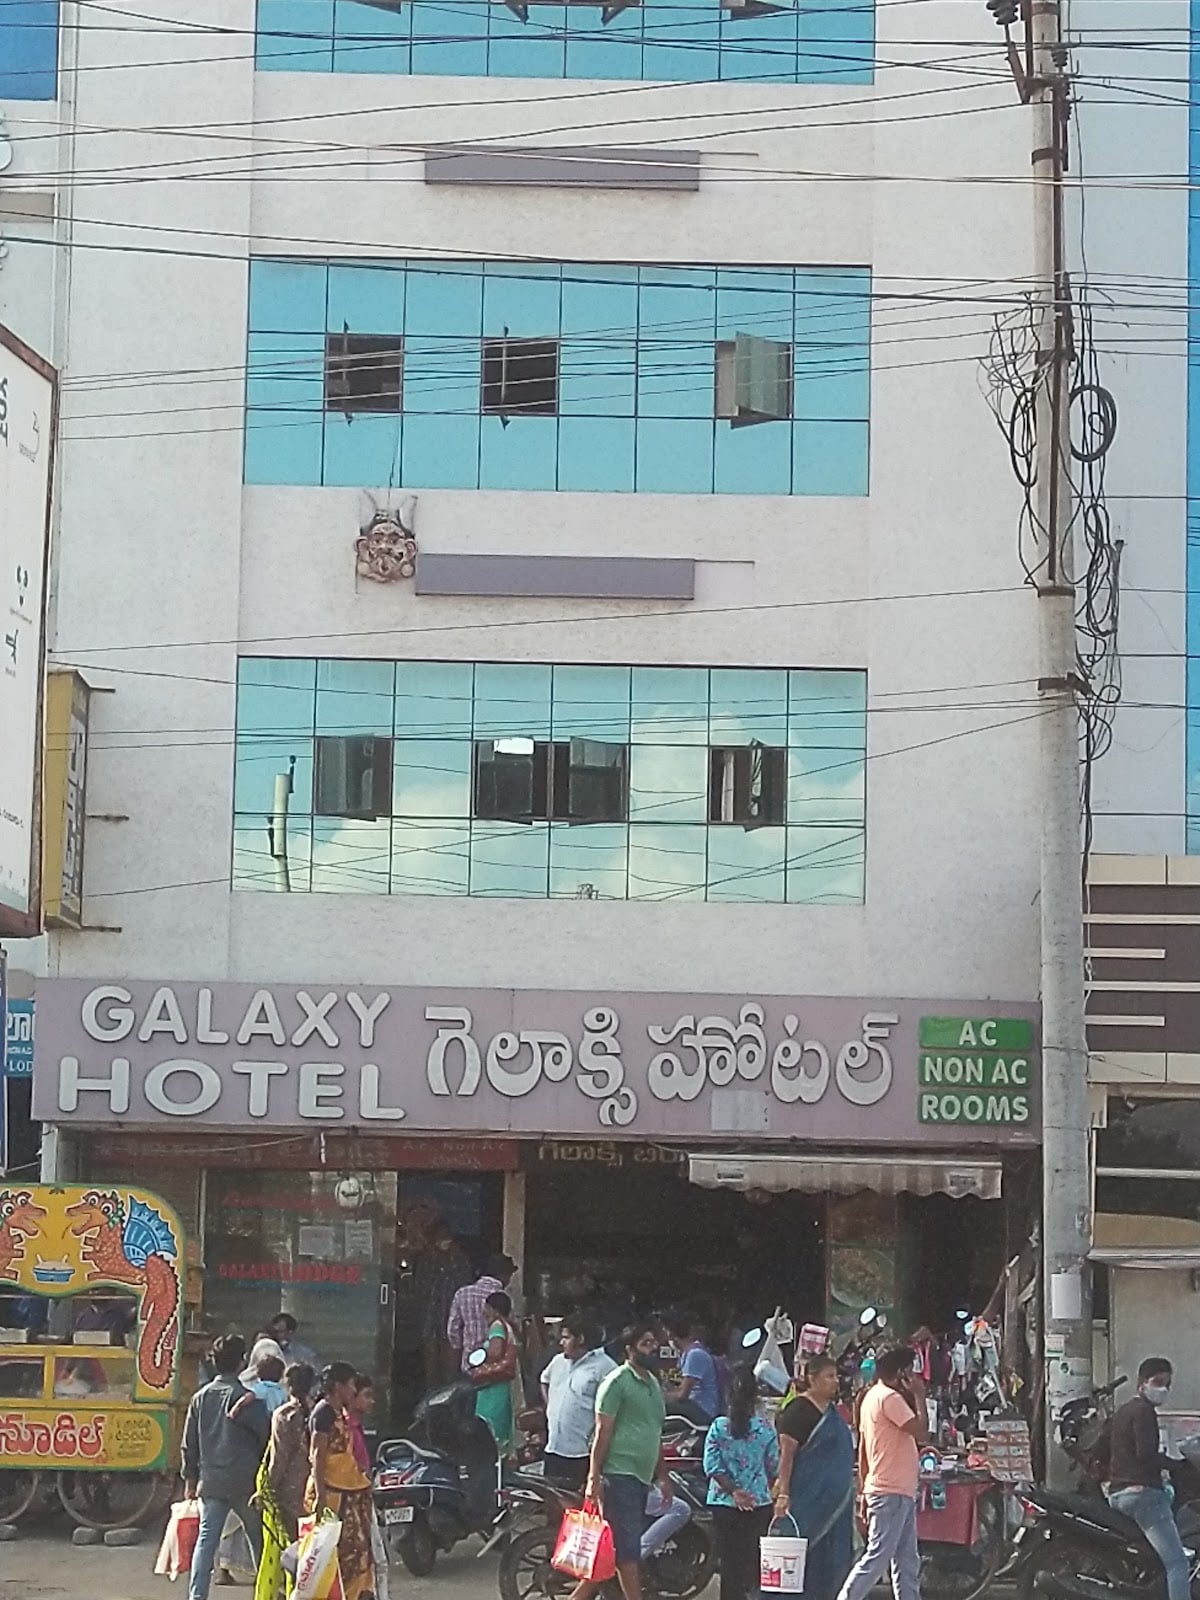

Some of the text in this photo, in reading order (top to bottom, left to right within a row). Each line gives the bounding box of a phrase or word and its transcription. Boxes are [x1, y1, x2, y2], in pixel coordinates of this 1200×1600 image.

[81, 985, 391, 1048] GALAXY
[959, 1020, 997, 1047] AC
[425, 1001, 900, 1126] గెలాక్సి హోటల్
[924, 1057, 1028, 1084] NON AC
[58, 1056, 407, 1120] HOTEL
[922, 1094, 1029, 1122] ROOMS
